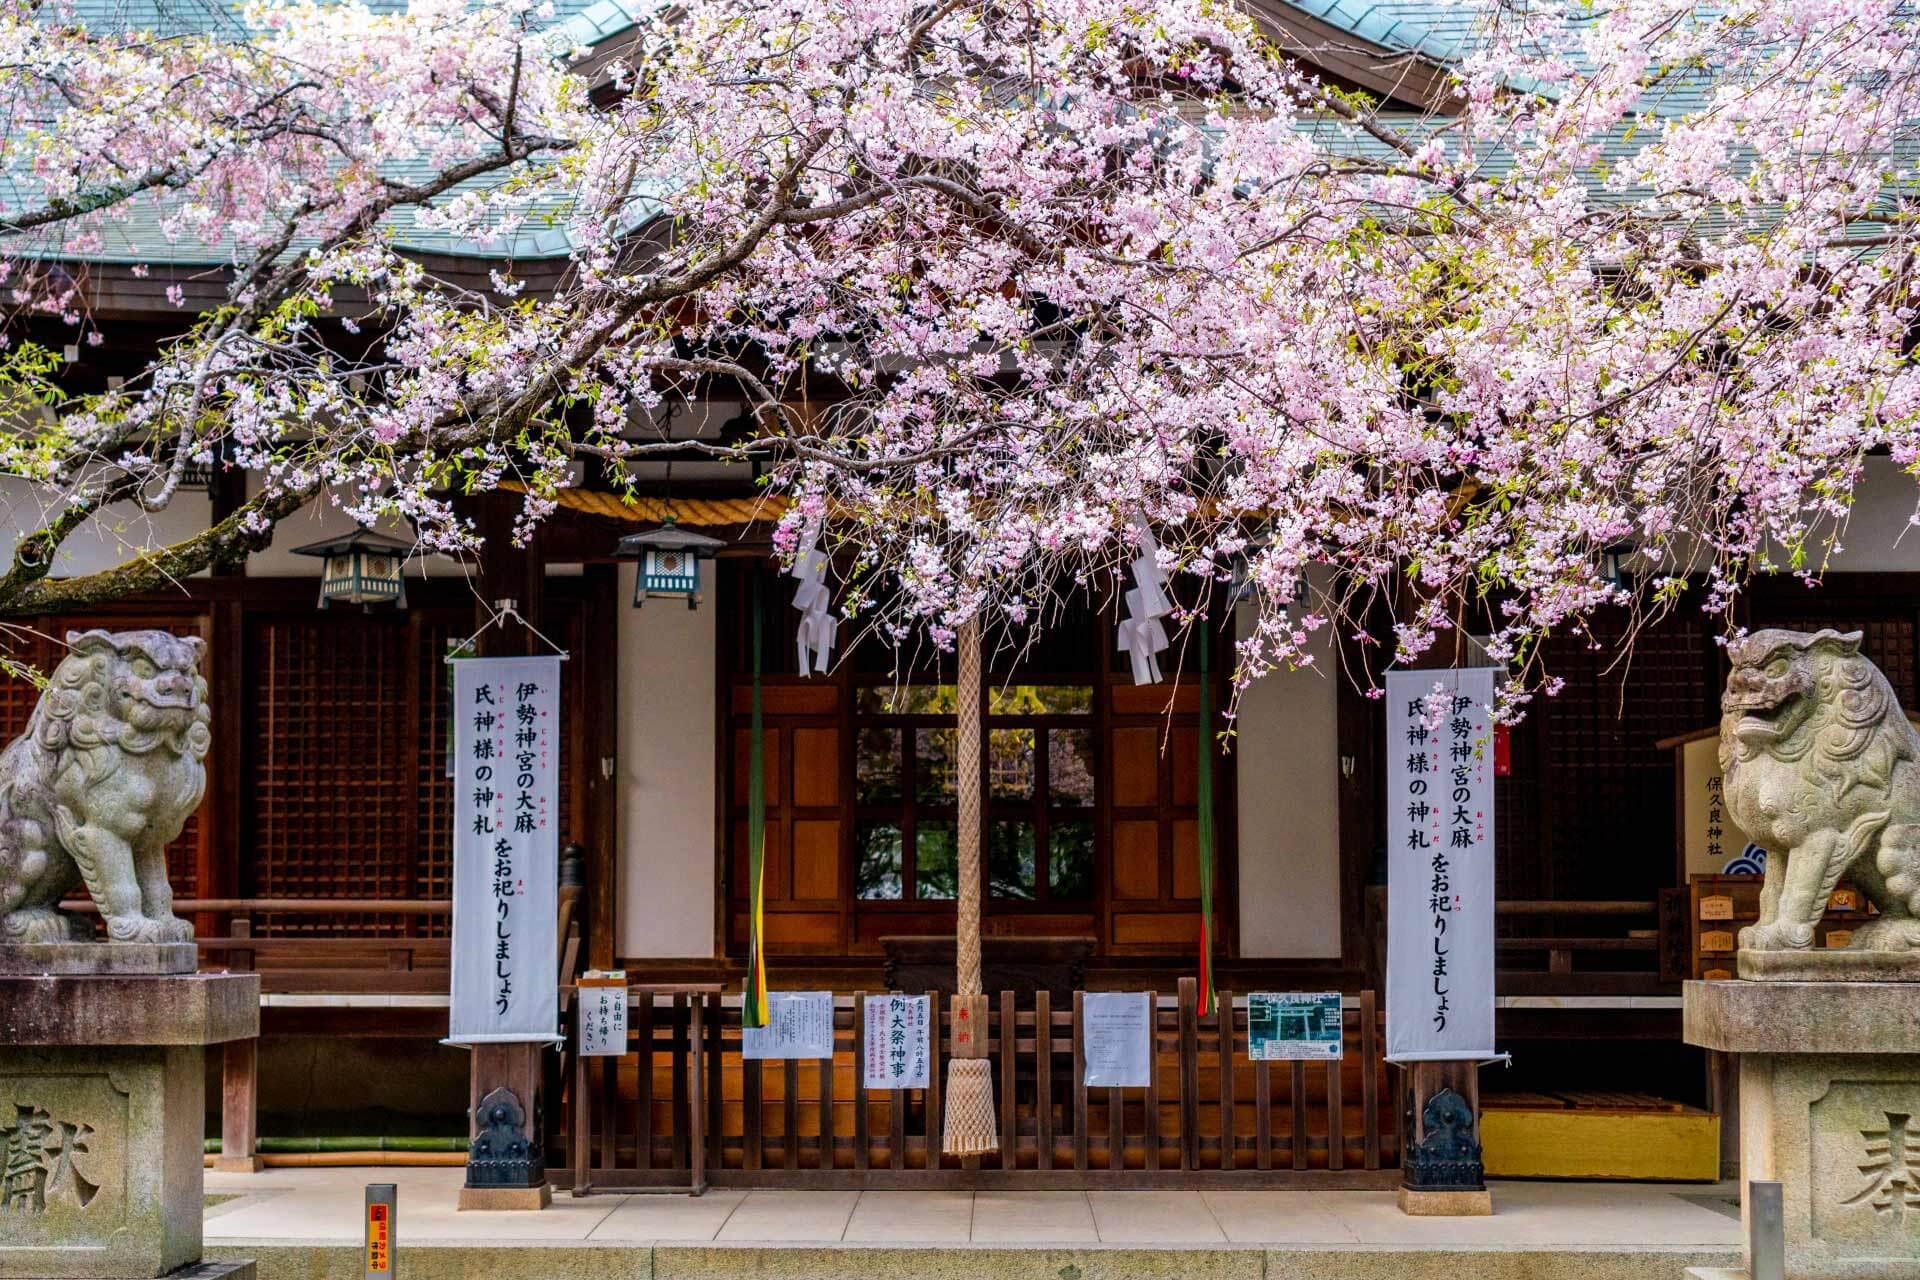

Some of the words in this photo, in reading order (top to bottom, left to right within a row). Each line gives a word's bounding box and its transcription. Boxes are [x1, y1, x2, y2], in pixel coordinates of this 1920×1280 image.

[473, 683, 495, 836] 氏神様の神札
[513, 682, 539, 833] 伊勢神宮の大麻
[1406, 697, 1430, 850] 氏神様の神札
[1450, 696, 1474, 849] 伊勢神宮の大麻
[1706, 776, 1723, 856] 保久良神社
[493, 838, 515, 1016] をお祀りしましょう
[1429, 852, 1452, 1032] をお祀りしましょう
[585, 1011, 594, 1051] ください
[599, 995, 609, 1046] お持ち帰り
[613, 991, 623, 1031] ご自由に
[890, 997, 906, 1078] 例大祭神事
